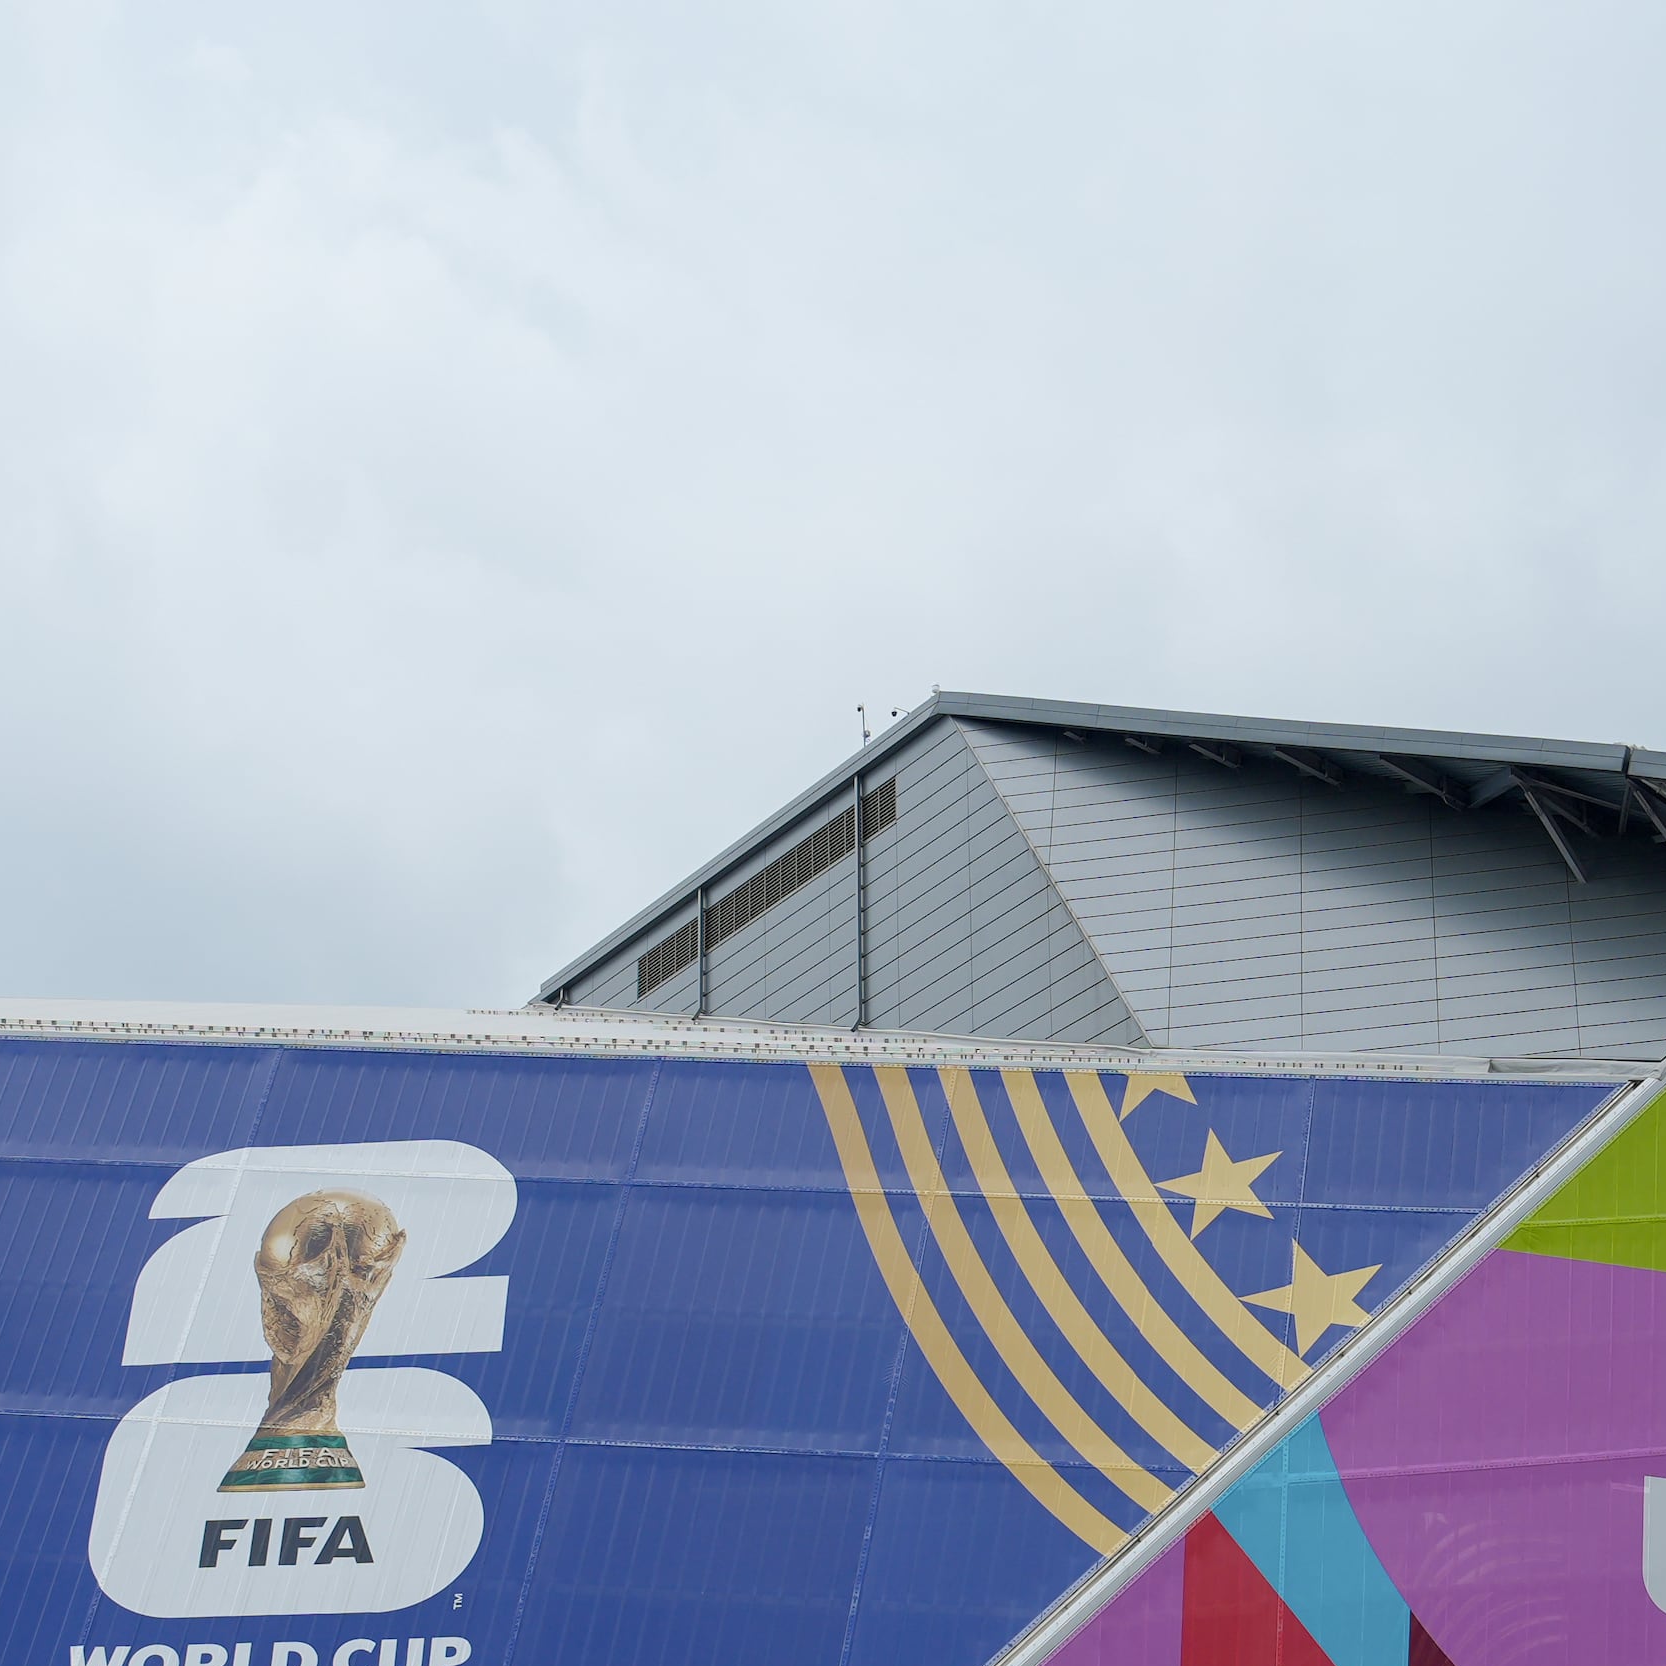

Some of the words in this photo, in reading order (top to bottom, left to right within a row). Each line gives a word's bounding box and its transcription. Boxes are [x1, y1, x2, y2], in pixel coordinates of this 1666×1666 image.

[263, 1447, 333, 1459] FIFA
[247, 1458, 310, 1469] WORLD
[316, 1457, 349, 1468] CUP
[198, 1515, 375, 1569] FIFA
